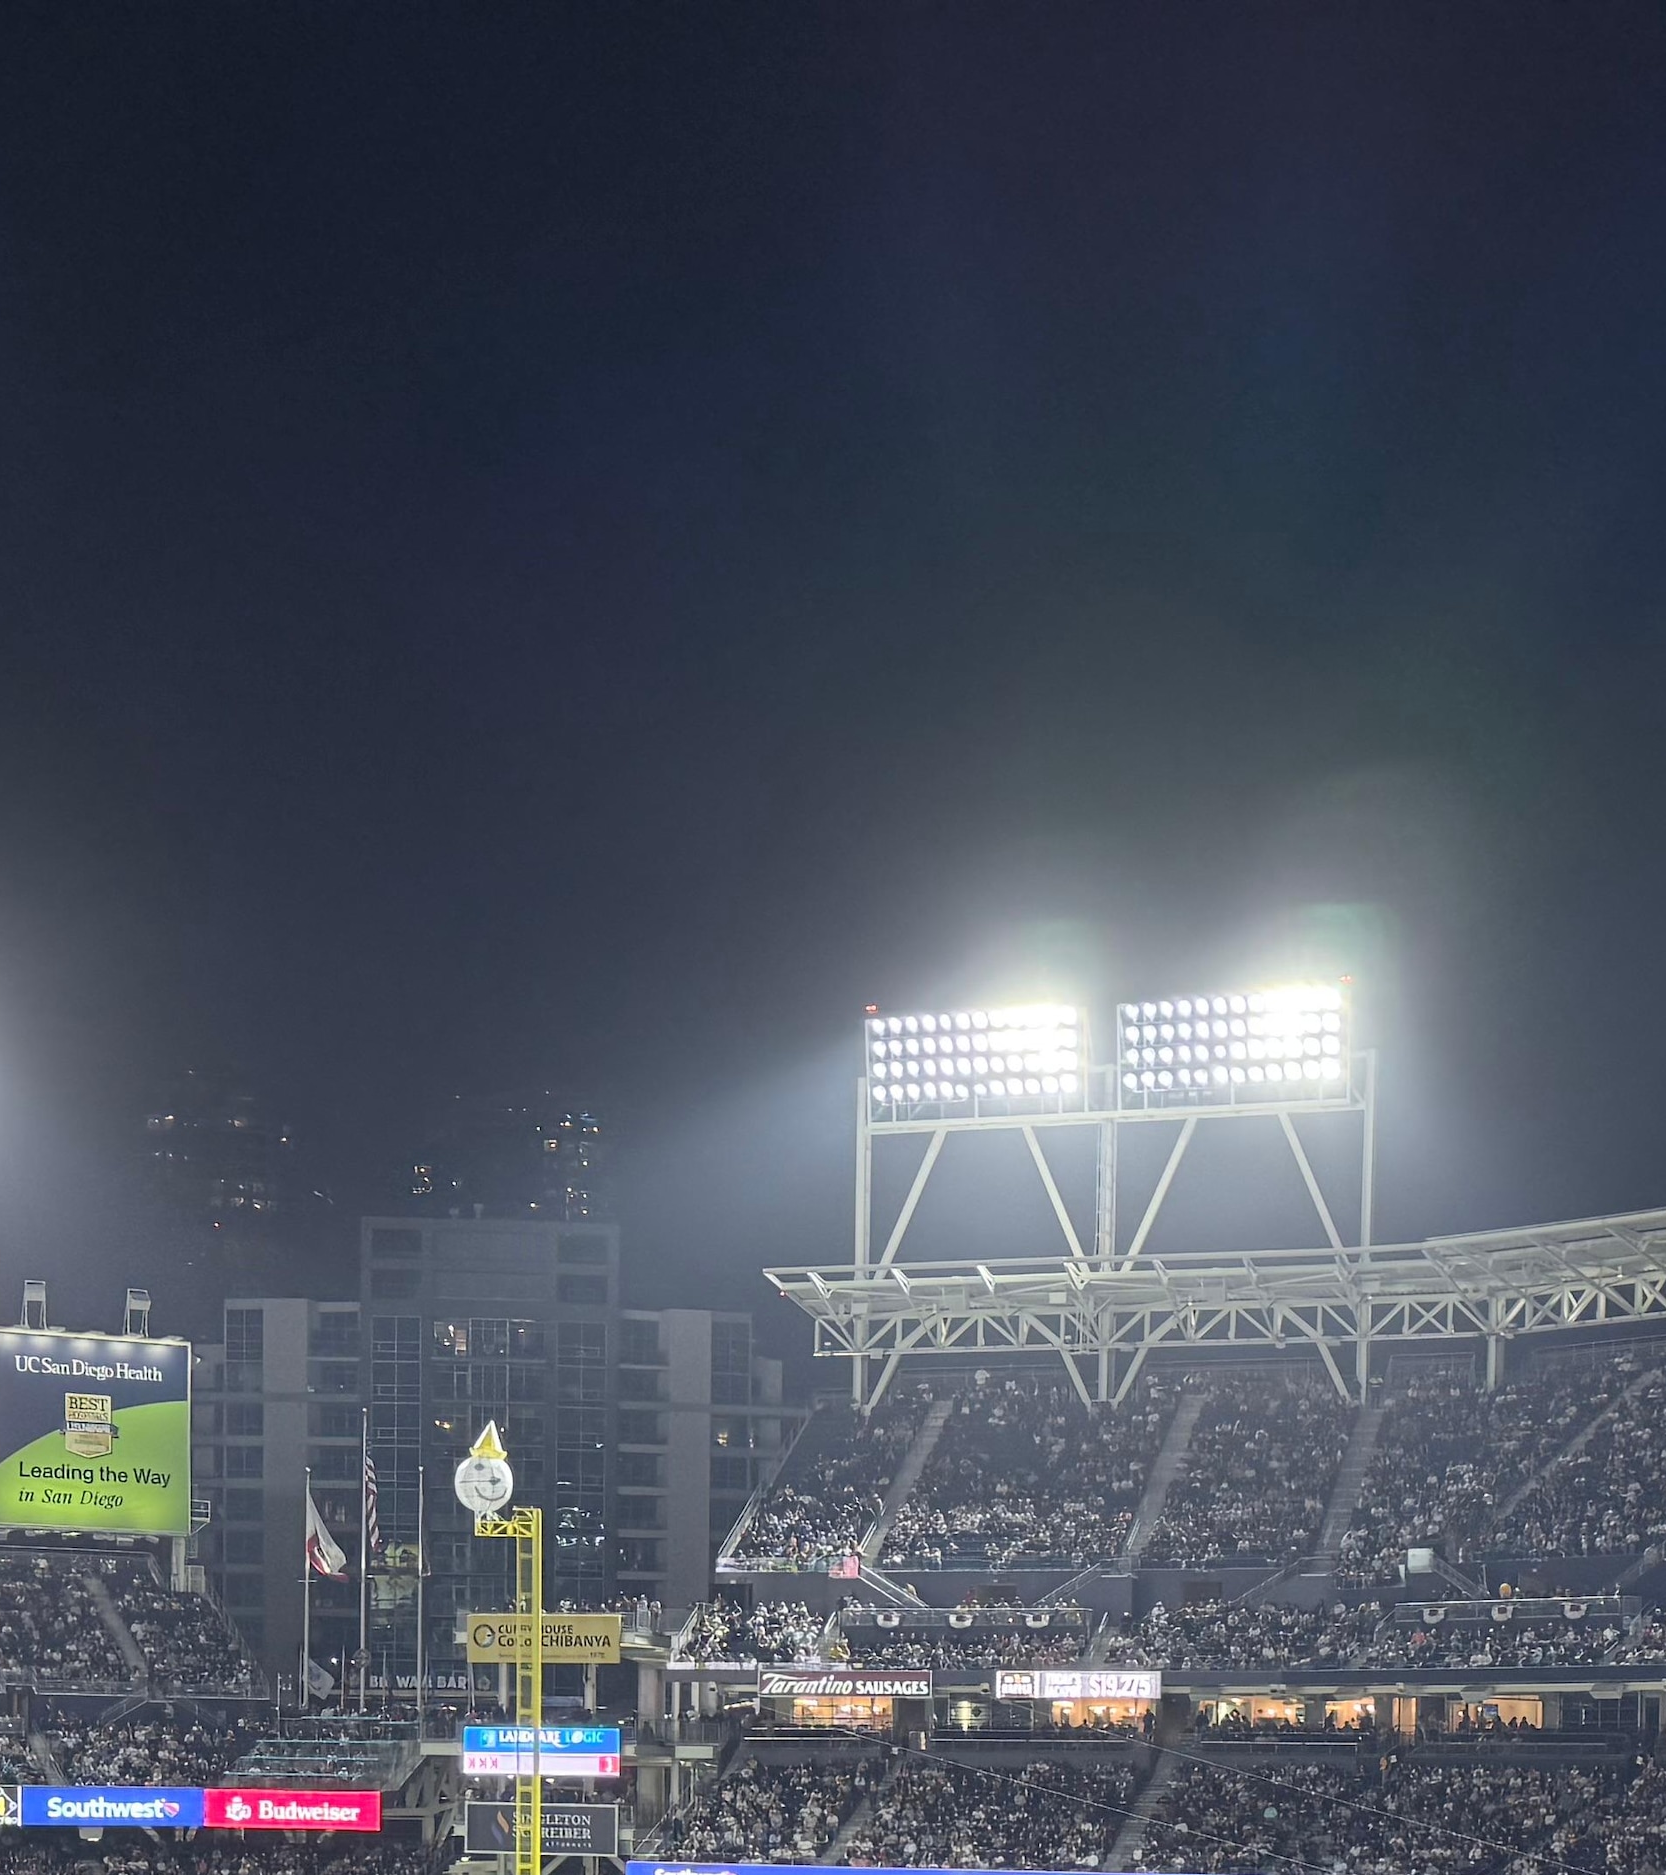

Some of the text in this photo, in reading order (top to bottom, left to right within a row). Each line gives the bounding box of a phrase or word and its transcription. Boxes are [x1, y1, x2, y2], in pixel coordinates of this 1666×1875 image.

[15, 1355, 163, 1382] UC San Diego Health
[69, 1396, 108, 1411] BEST
[19, 1461, 171, 1488] Leading the Way
[19, 1488, 123, 1509] in San Diego
[761, 1673, 928, 1696] Tarantino SAUSAGES
[565, 1730, 604, 1743] LOGIC
[47, 1796, 164, 1818] Southwest
[258, 1800, 361, 1821] Budweiser
